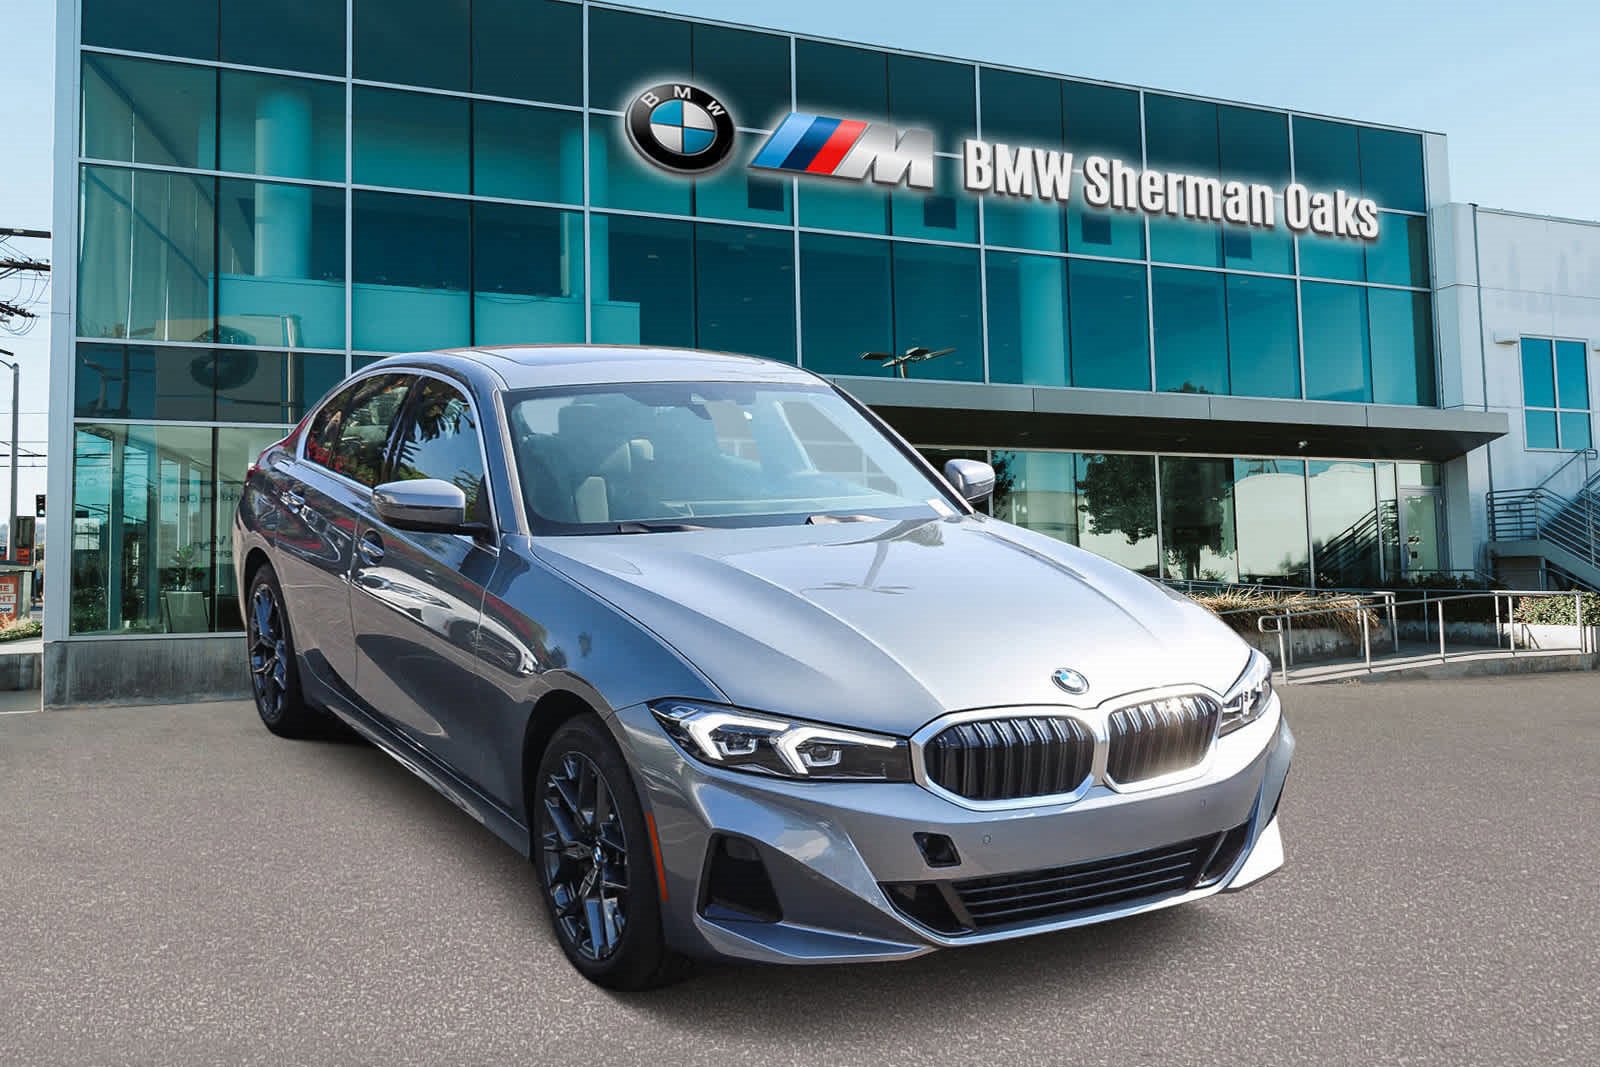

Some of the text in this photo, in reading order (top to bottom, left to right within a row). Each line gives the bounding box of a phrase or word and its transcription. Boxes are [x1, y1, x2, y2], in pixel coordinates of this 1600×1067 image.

[640, 85, 725, 117] BMW
[964, 138, 1379, 240] BMW Sherman Oaks
